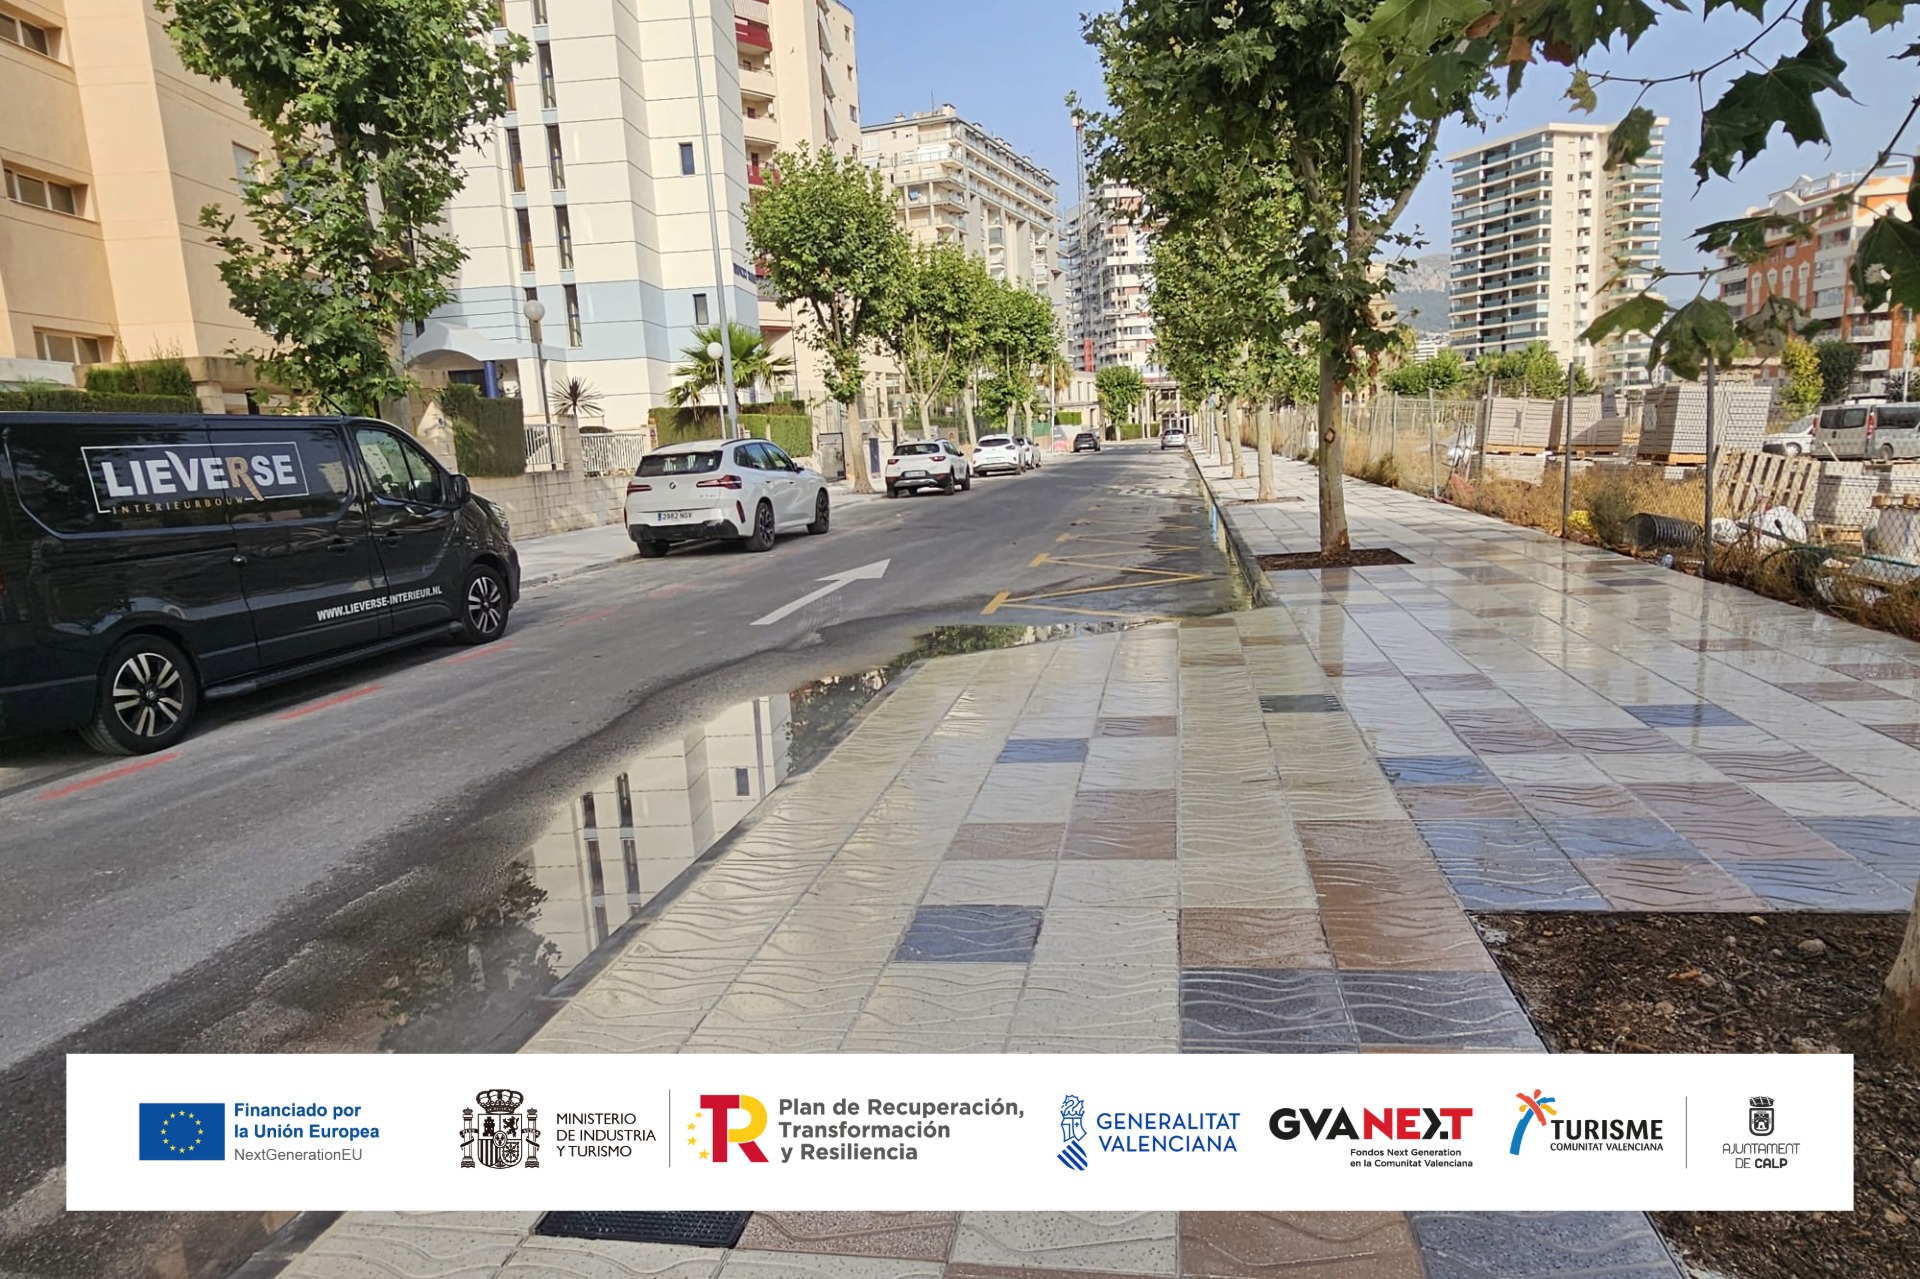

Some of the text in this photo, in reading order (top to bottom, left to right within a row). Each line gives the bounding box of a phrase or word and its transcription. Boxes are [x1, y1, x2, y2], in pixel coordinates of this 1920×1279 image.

[102, 450, 297, 501] LIEVERSE
[112, 496, 244, 515] INTERIEURBOUW
[316, 585, 443, 621] WWW.LIEVERSE-INTERIEUR.NL
